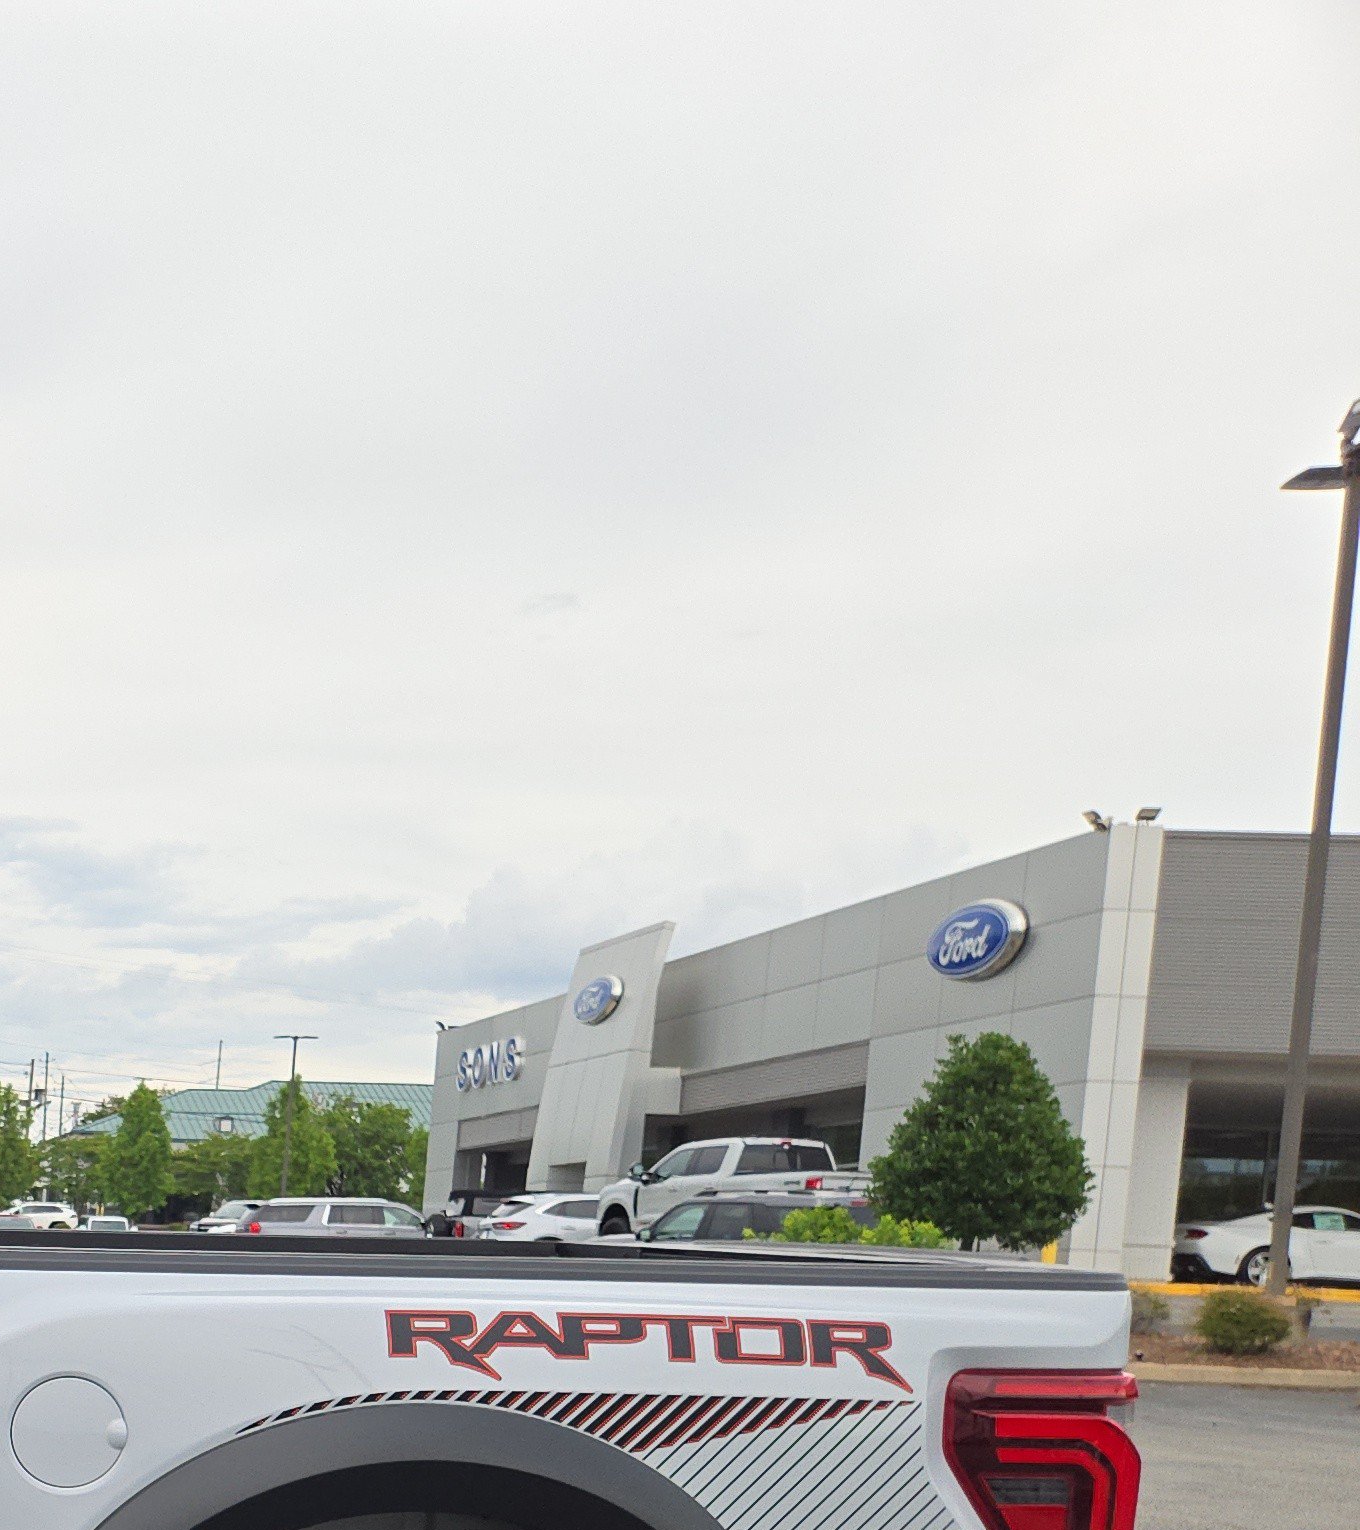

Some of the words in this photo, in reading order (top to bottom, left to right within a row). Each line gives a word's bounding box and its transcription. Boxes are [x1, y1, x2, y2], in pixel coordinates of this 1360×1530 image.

[938, 917, 992, 966] Ford
[456, 1037, 520, 1092] SONS
[384, 1309, 914, 1393] RAPTOR
